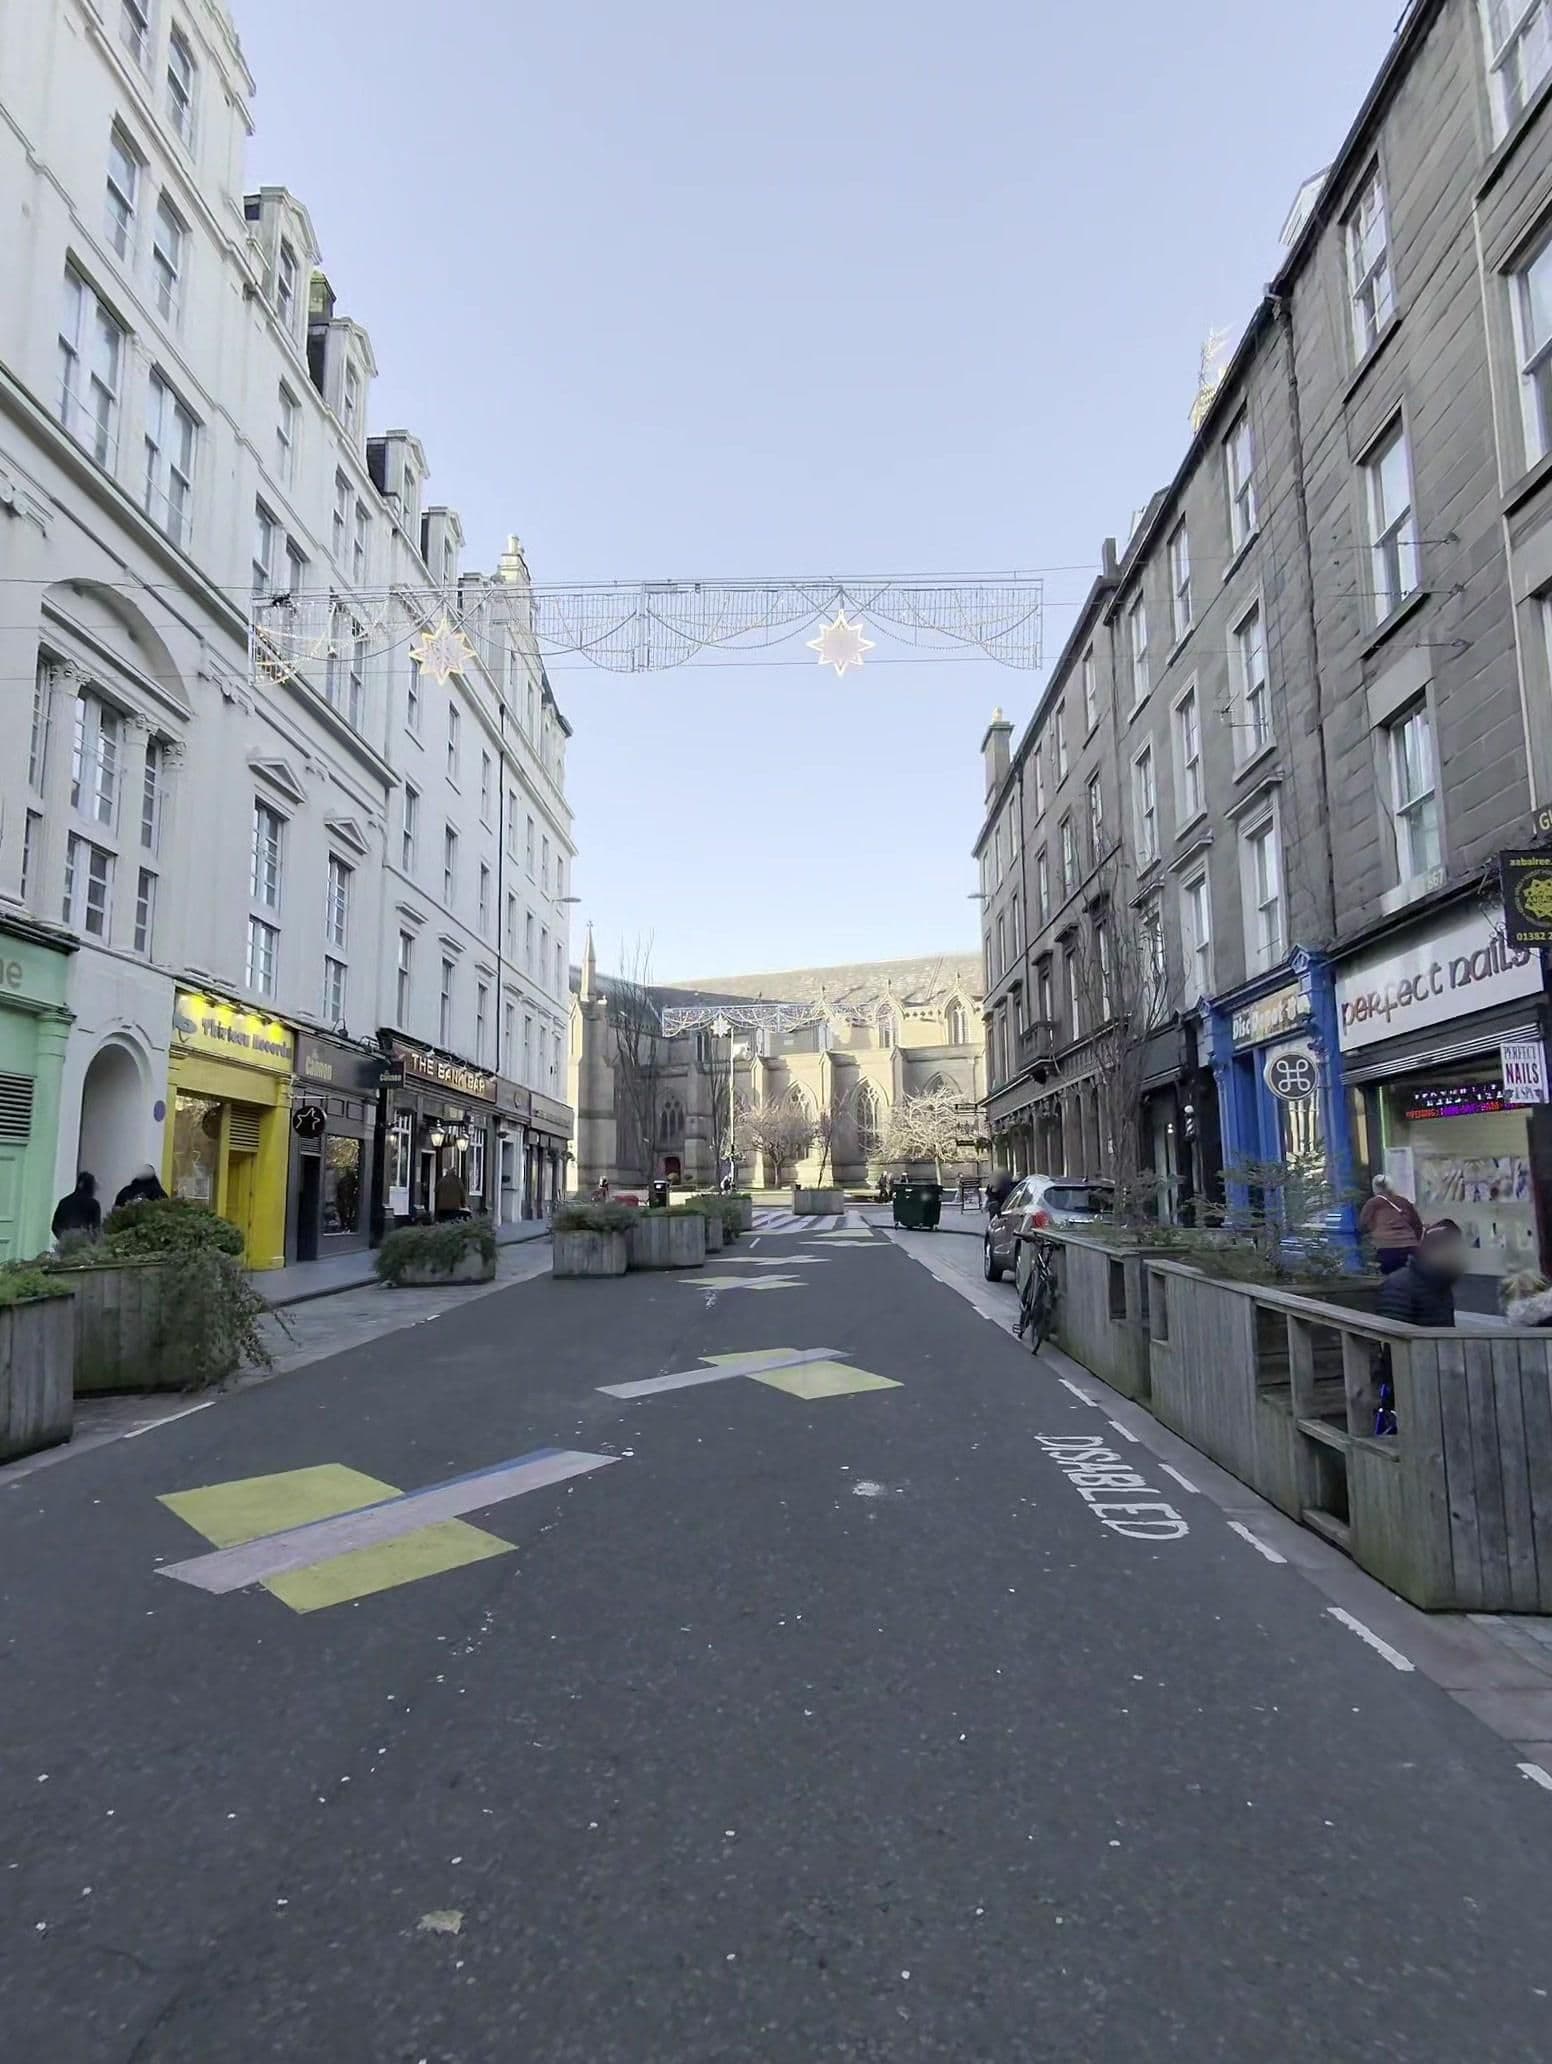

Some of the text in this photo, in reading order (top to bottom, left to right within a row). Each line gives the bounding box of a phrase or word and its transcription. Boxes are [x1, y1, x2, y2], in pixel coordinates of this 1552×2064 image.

[1516, 932, 1546, 941] 01382
[1341, 962, 1443, 1036] perfect
[1504, 1046, 1537, 1060] PERFECT
[411, 1053, 486, 1094] THE BANK BAR
[1506, 1063, 1539, 1084] NAILS
[1034, 1436, 1190, 1540] DISABLED
